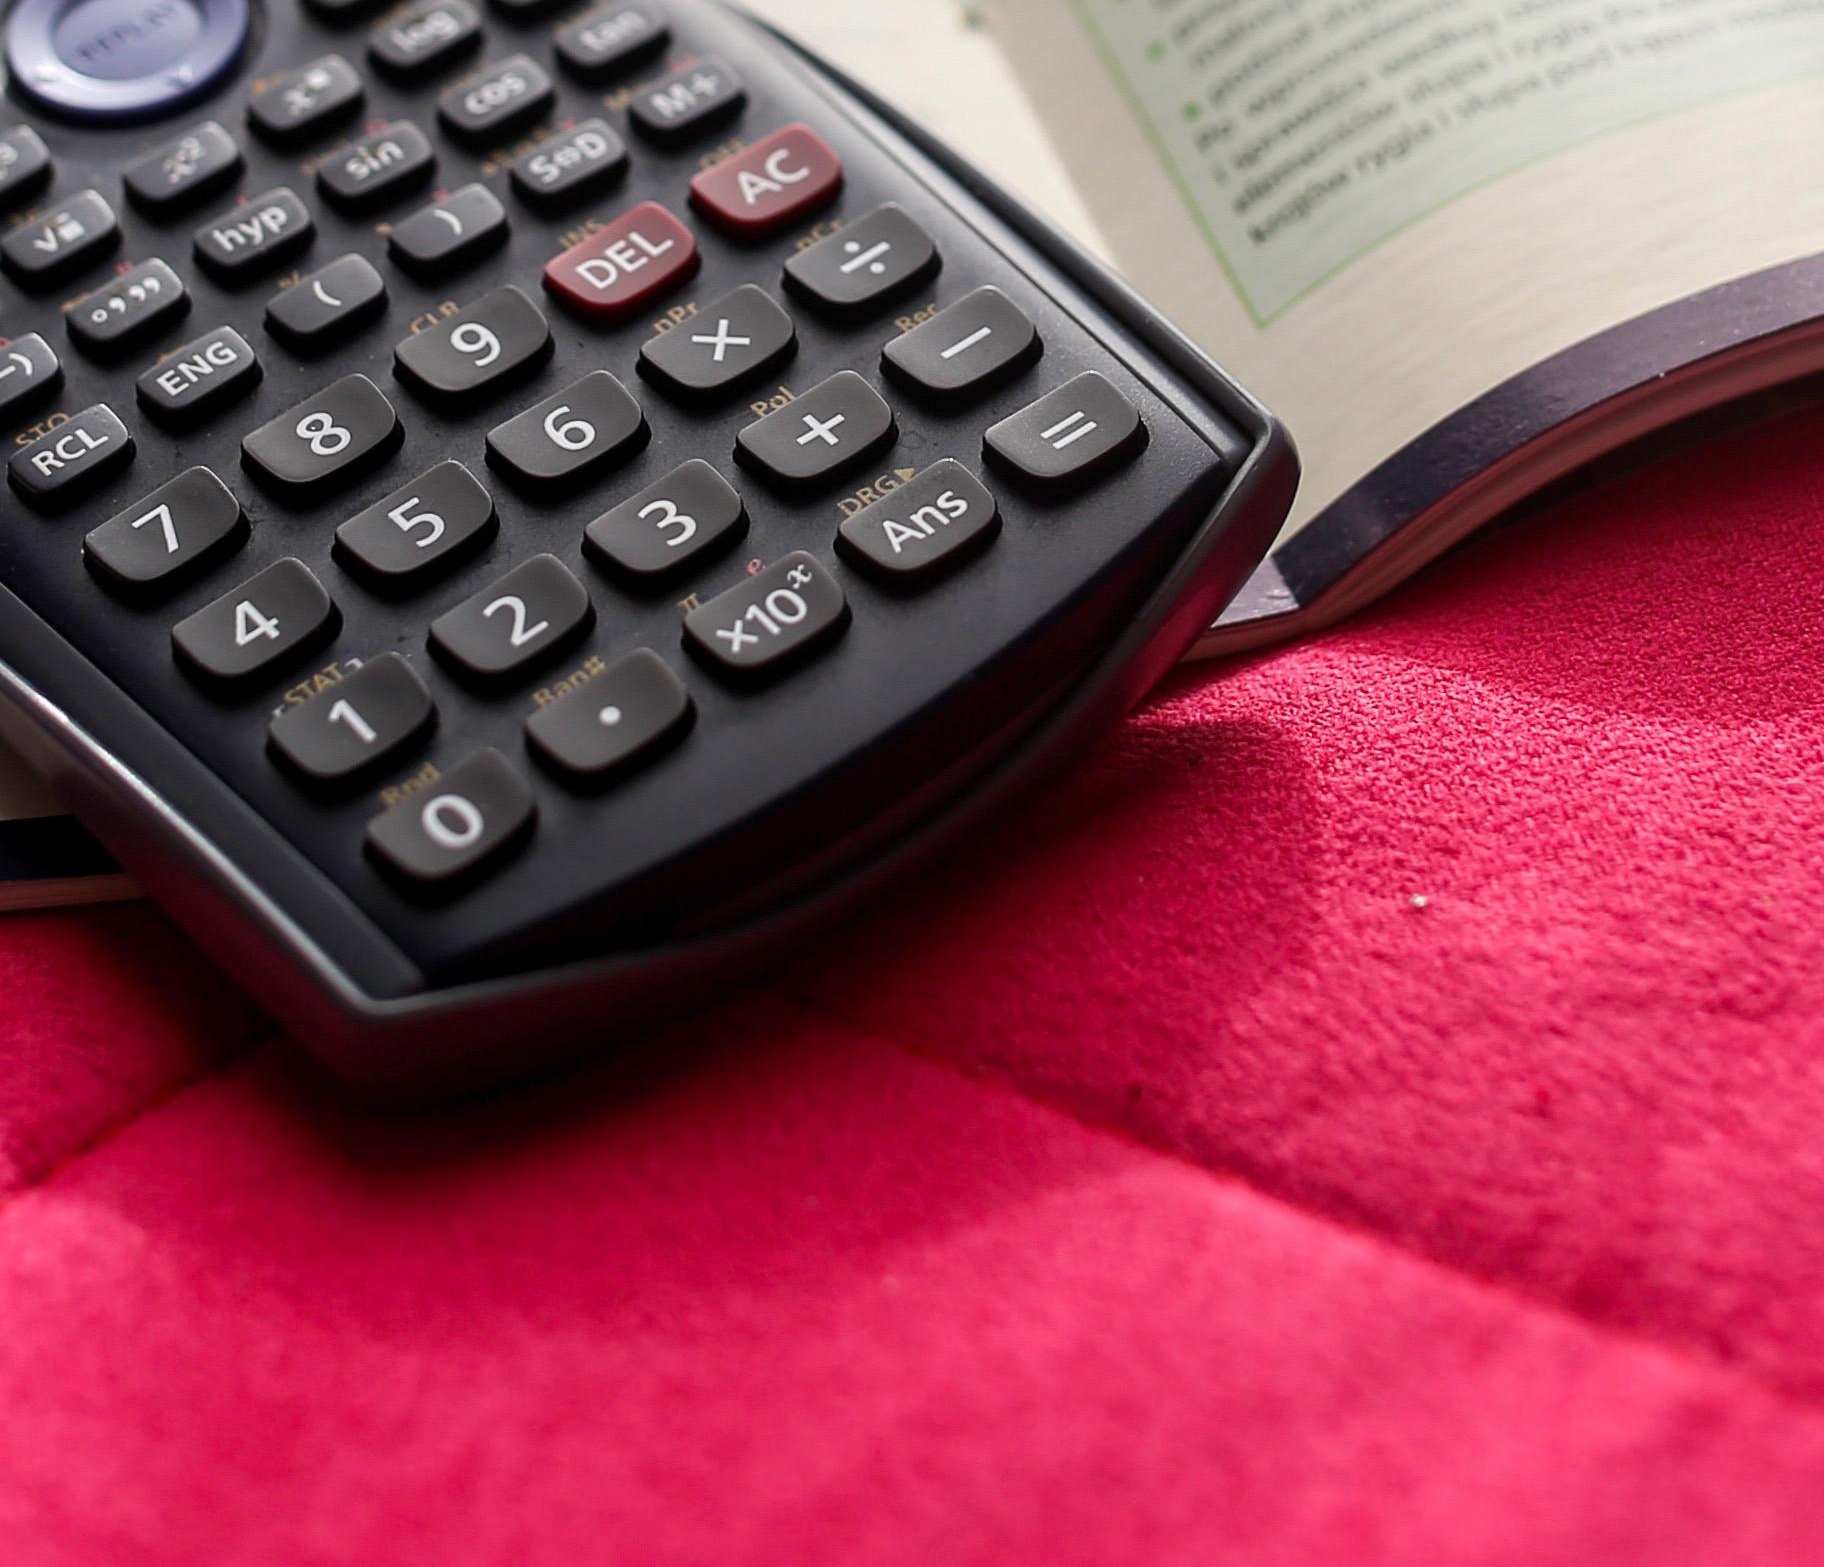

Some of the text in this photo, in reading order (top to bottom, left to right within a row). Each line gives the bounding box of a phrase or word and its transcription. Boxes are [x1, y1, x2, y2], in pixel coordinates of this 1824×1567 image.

[464, 72, 527, 116] cos
[650, 73, 718, 118] M+
[345, 139, 404, 181] sin
[735, 147, 813, 206] AC
[213, 204, 289, 253] hyp
[575, 229, 675, 292] DEL
[155, 340, 240, 398] ENG
[449, 322, 502, 367] 9
[749, 384, 798, 419] Pol
[294, 411, 352, 456] 8
[542, 405, 597, 452] 6
[31, 428, 110, 479] RCL
[131, 502, 179, 554] 7
[386, 495, 447, 548] 5
[637, 498, 698, 548] 3
[880, 489, 970, 555] Ans
[233, 599, 281, 647] 4
[482, 595, 550, 647] 2
[531, 655, 607, 709] Ran#
[328, 698, 377, 743] 1
[381, 762, 442, 809] Rnd
[420, 792, 484, 850] 0
